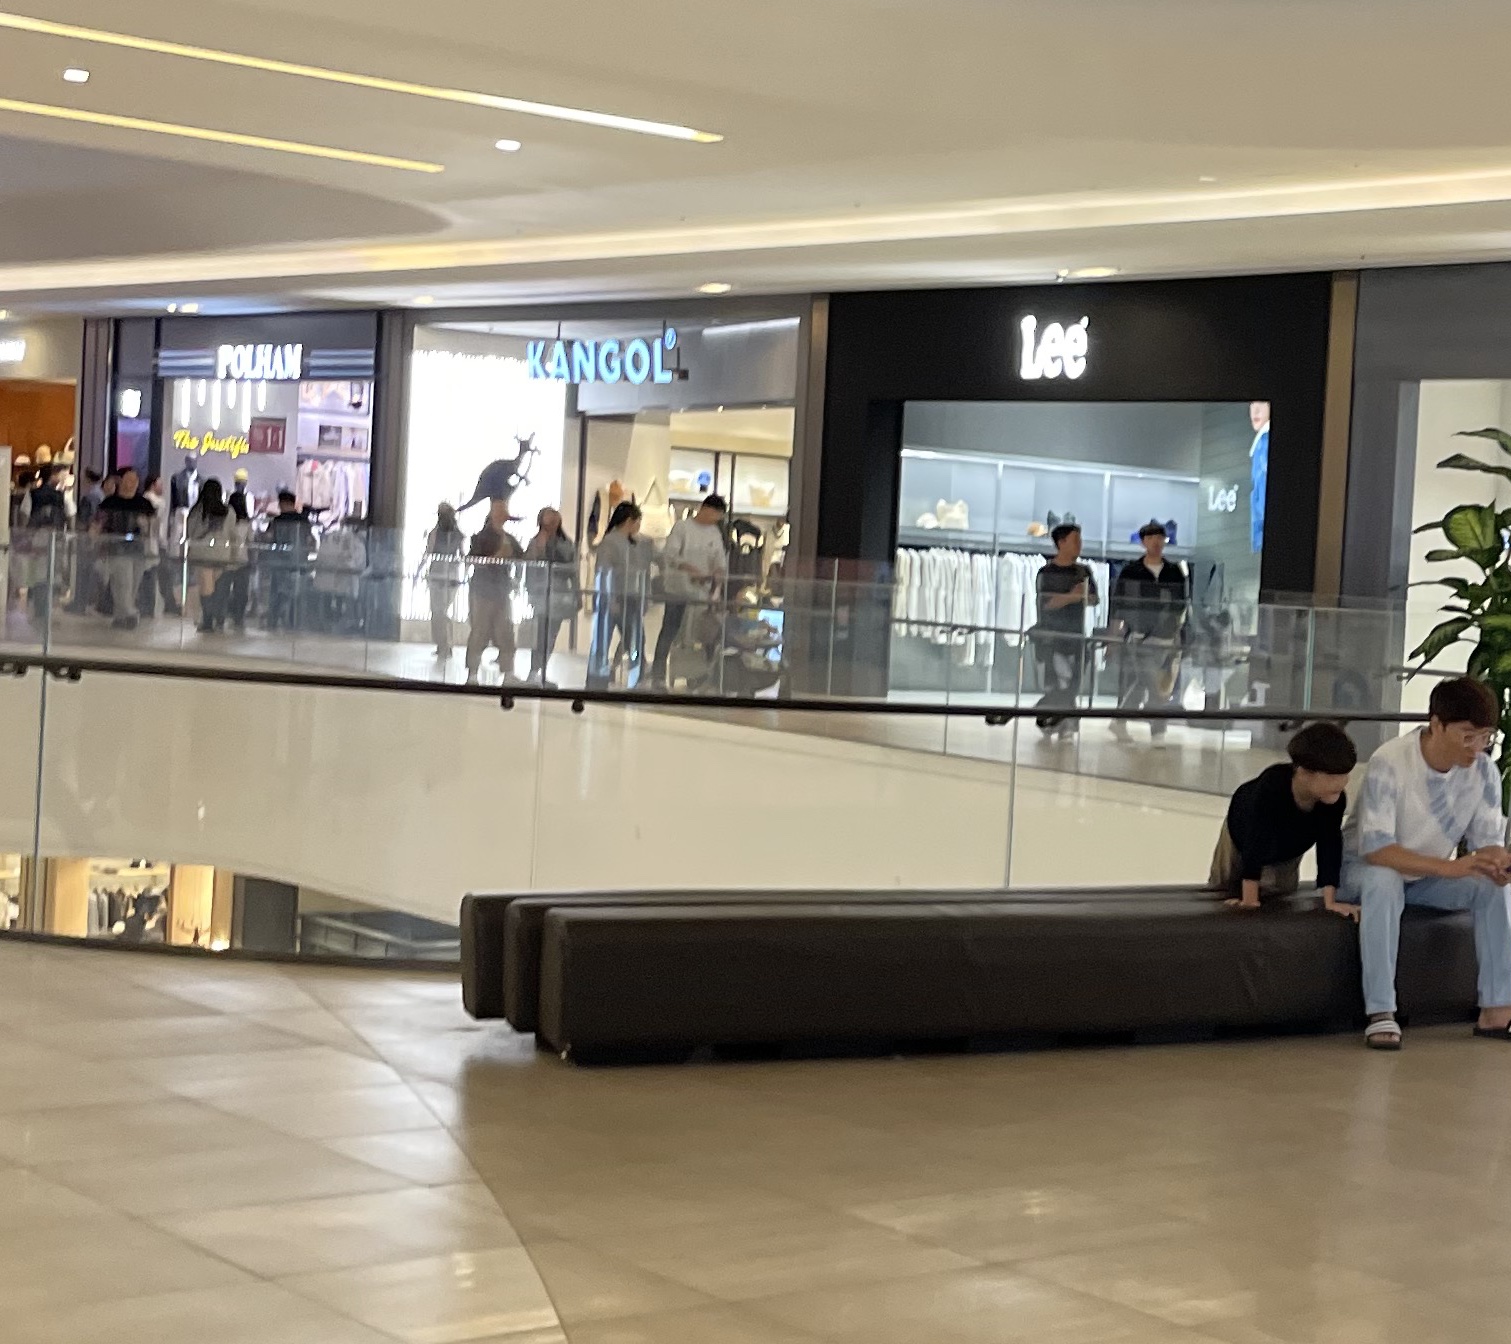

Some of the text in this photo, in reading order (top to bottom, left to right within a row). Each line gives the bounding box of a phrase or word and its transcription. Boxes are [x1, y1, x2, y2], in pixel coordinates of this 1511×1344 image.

[217, 343, 303, 380] POLHAM
[526, 334, 674, 385] KANGOL
[1020, 314, 1089, 380] Lee
[1208, 484, 1239, 512] Lee
